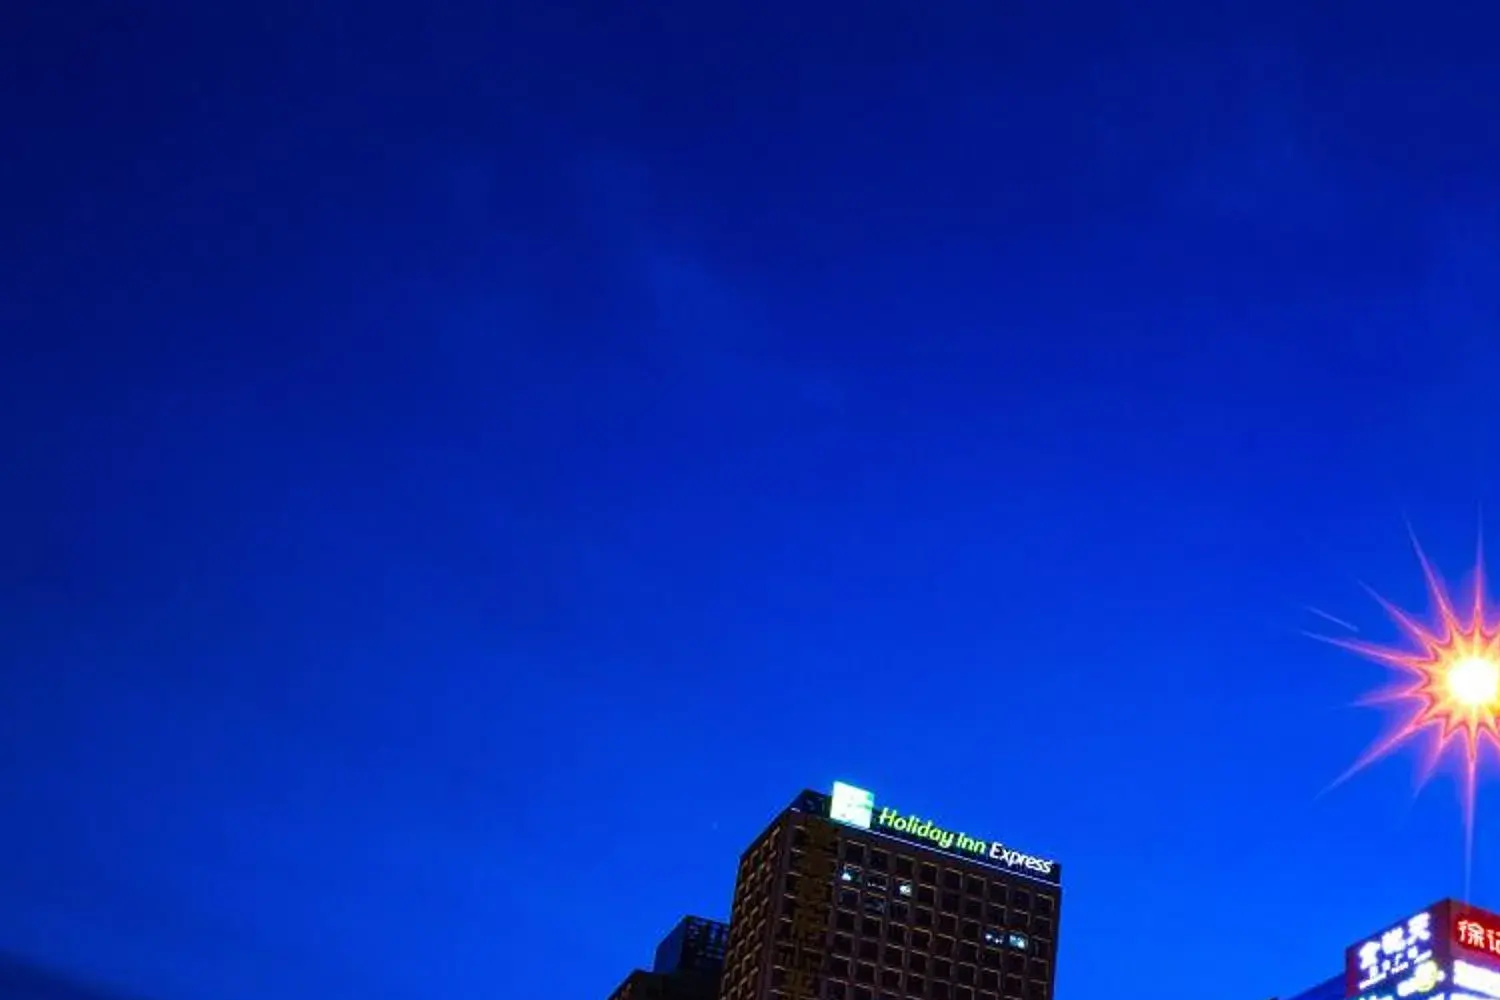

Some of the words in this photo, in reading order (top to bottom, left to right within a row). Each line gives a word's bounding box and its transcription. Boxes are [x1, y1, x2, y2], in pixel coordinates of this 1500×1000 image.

[879, 807, 954, 848] Holiday
[956, 832, 986, 855] Inn
[989, 842, 1052, 873] Express
